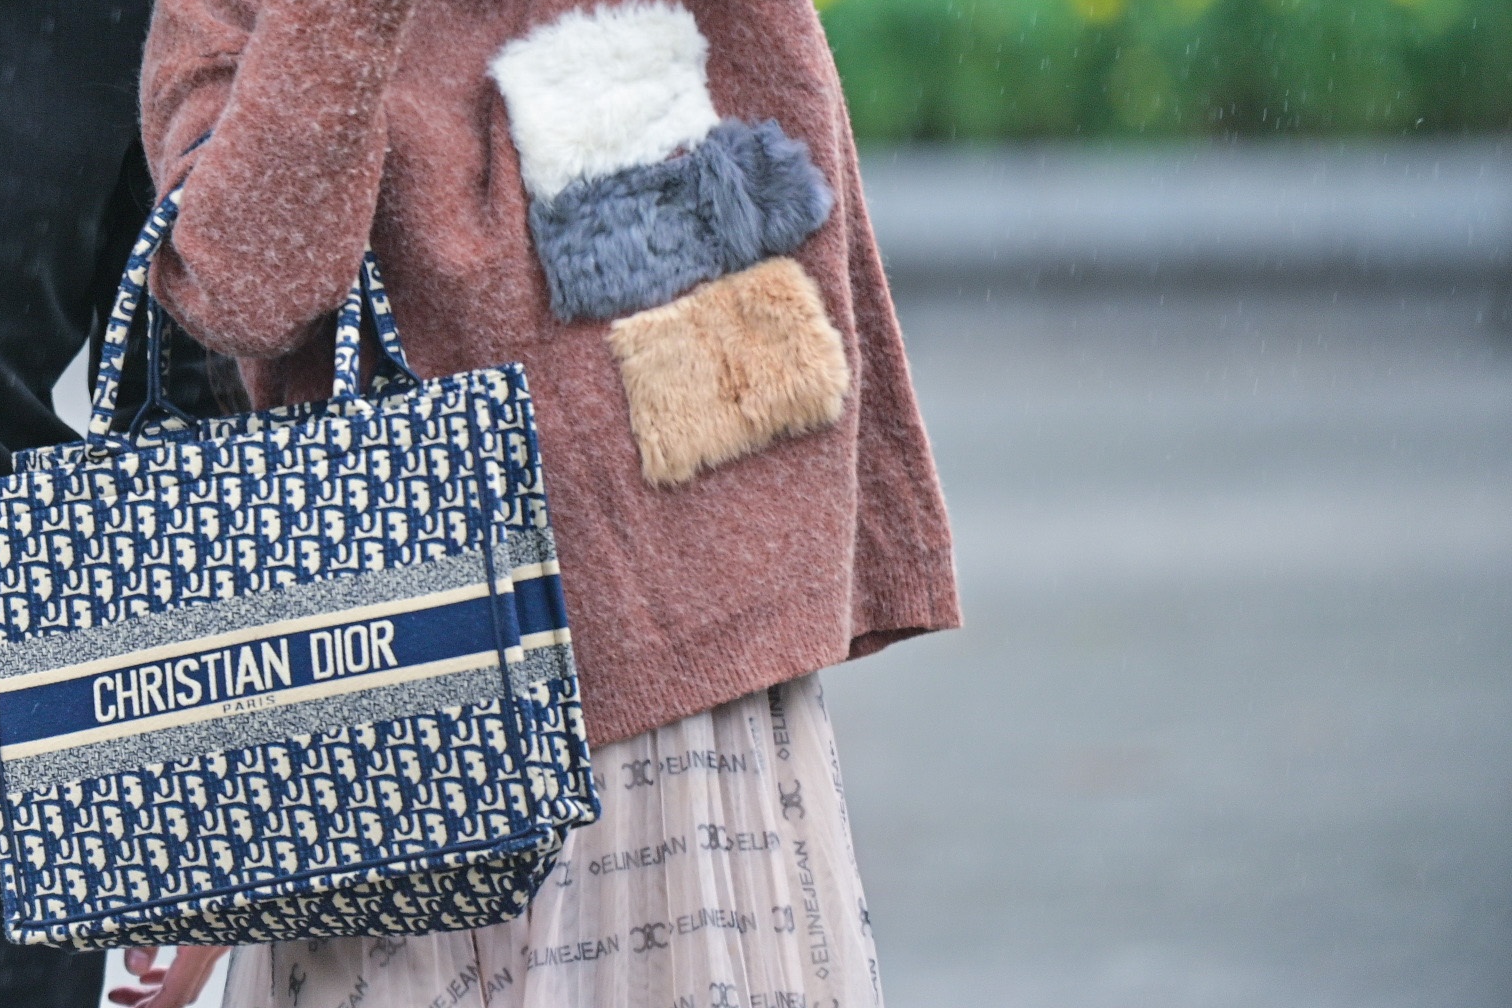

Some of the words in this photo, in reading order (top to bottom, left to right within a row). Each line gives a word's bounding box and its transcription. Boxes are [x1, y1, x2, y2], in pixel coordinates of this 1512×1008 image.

[93, 638, 292, 723] CHRISTIAN
[309, 620, 399, 681] DIOR
[222, 694, 277, 714] PARIS
